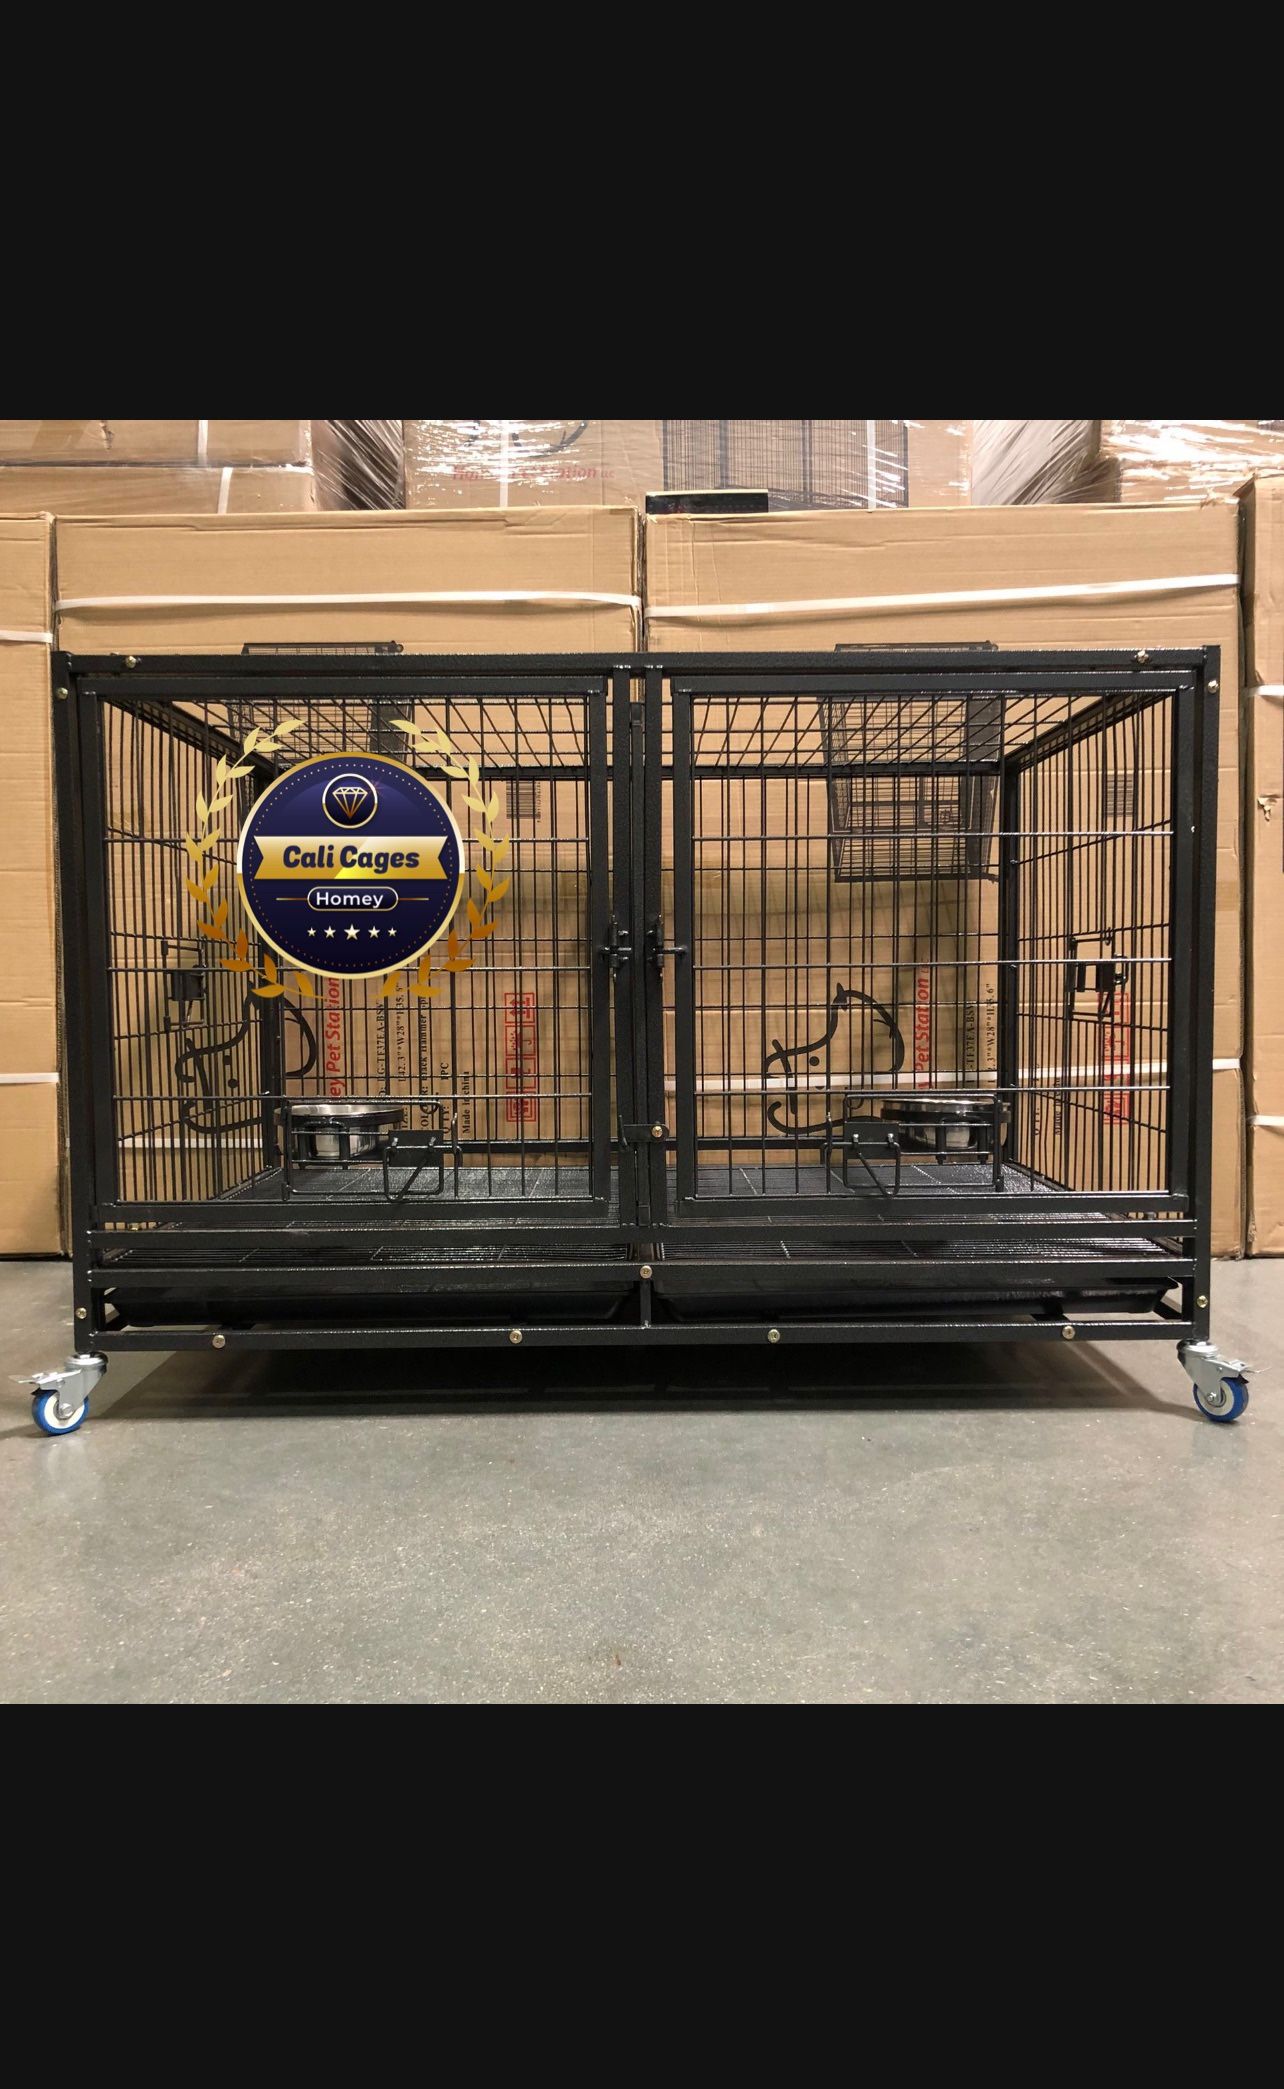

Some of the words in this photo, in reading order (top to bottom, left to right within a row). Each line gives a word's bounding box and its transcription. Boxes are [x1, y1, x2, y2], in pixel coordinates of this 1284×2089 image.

[323, 977, 341, 1041] Staion
[914, 978, 930, 1043] Staton
[325, 1043, 341, 1073] Pet
[462, 1109, 472, 1134] Made
